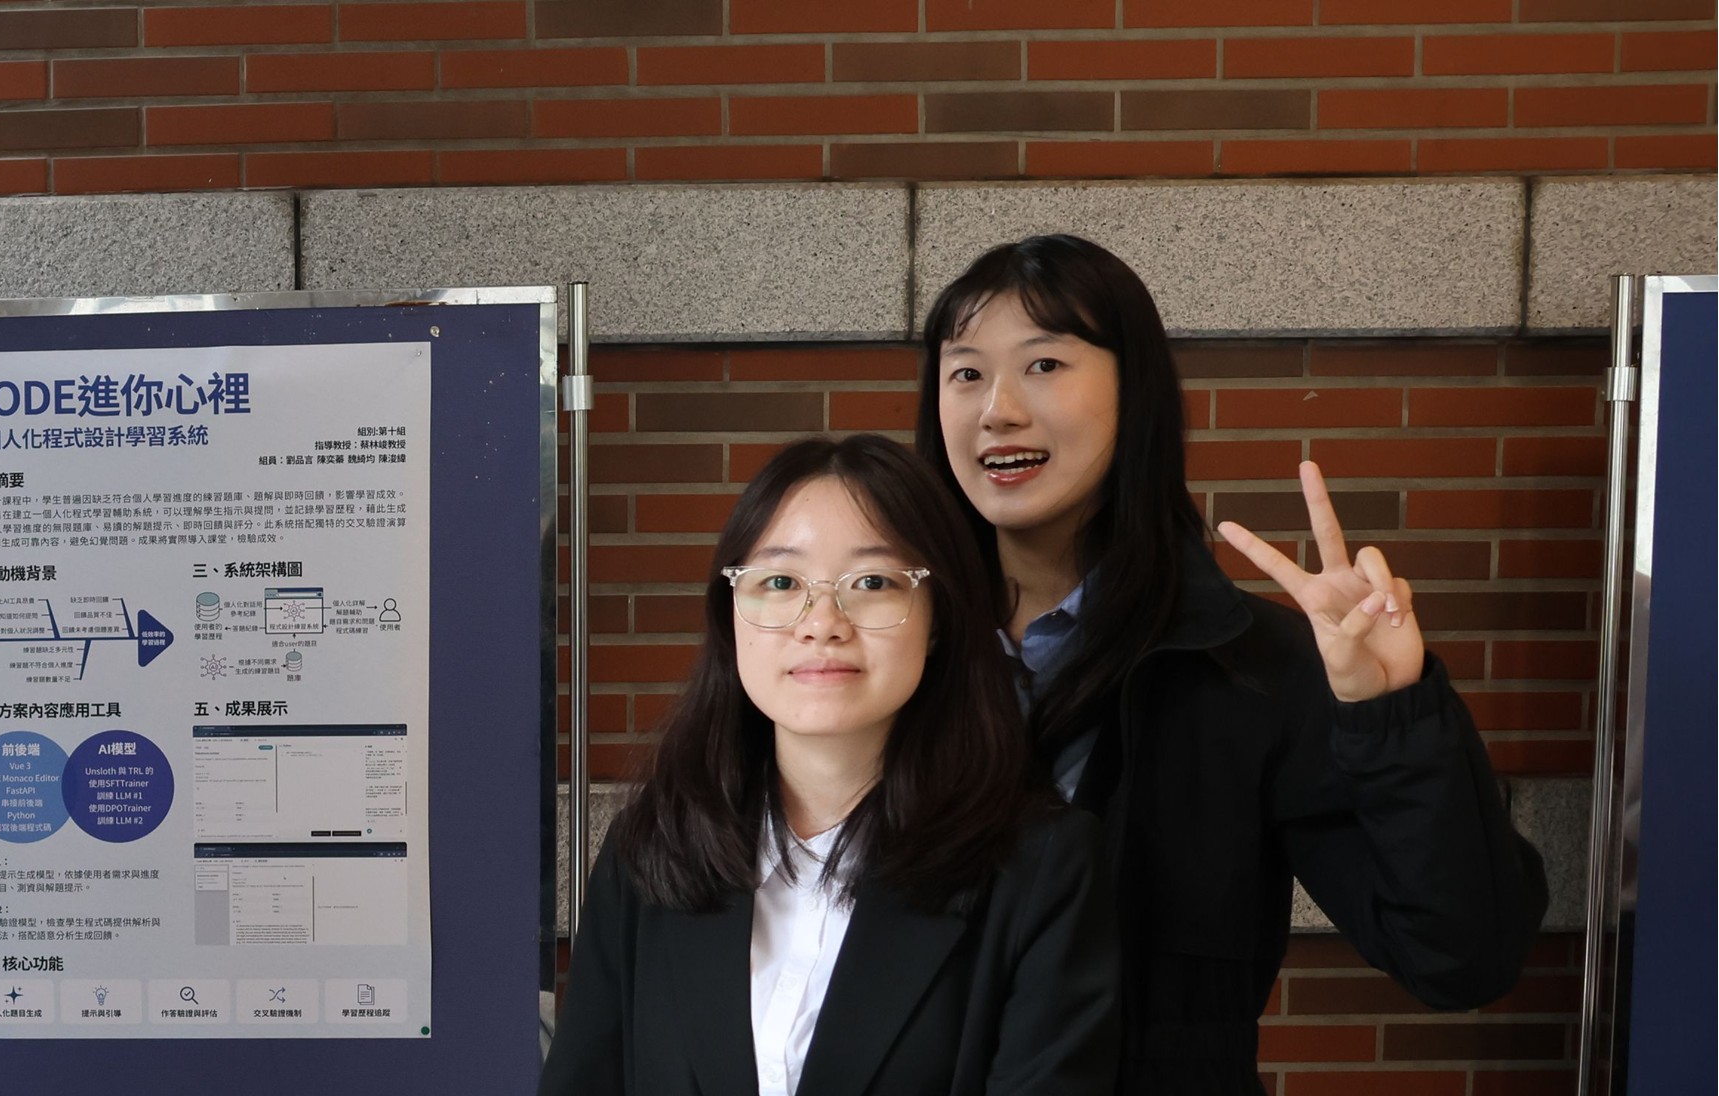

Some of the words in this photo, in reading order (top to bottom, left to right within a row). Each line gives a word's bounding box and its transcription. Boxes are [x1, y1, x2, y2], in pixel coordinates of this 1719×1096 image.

[192, 561, 303, 578] 三、系統架構圖
[194, 700, 288, 717] 五、成果展示
[1, 743, 40, 757] 前後端
[98, 741, 137, 756] AI模型
[85, 767, 117, 775] Unsloth
[128, 767, 143, 775] TRL
[35, 774, 60, 782] Editor
[115, 792, 132, 800] LLM
[7, 811, 36, 820] Python
[115, 817, 132, 825] LLM
